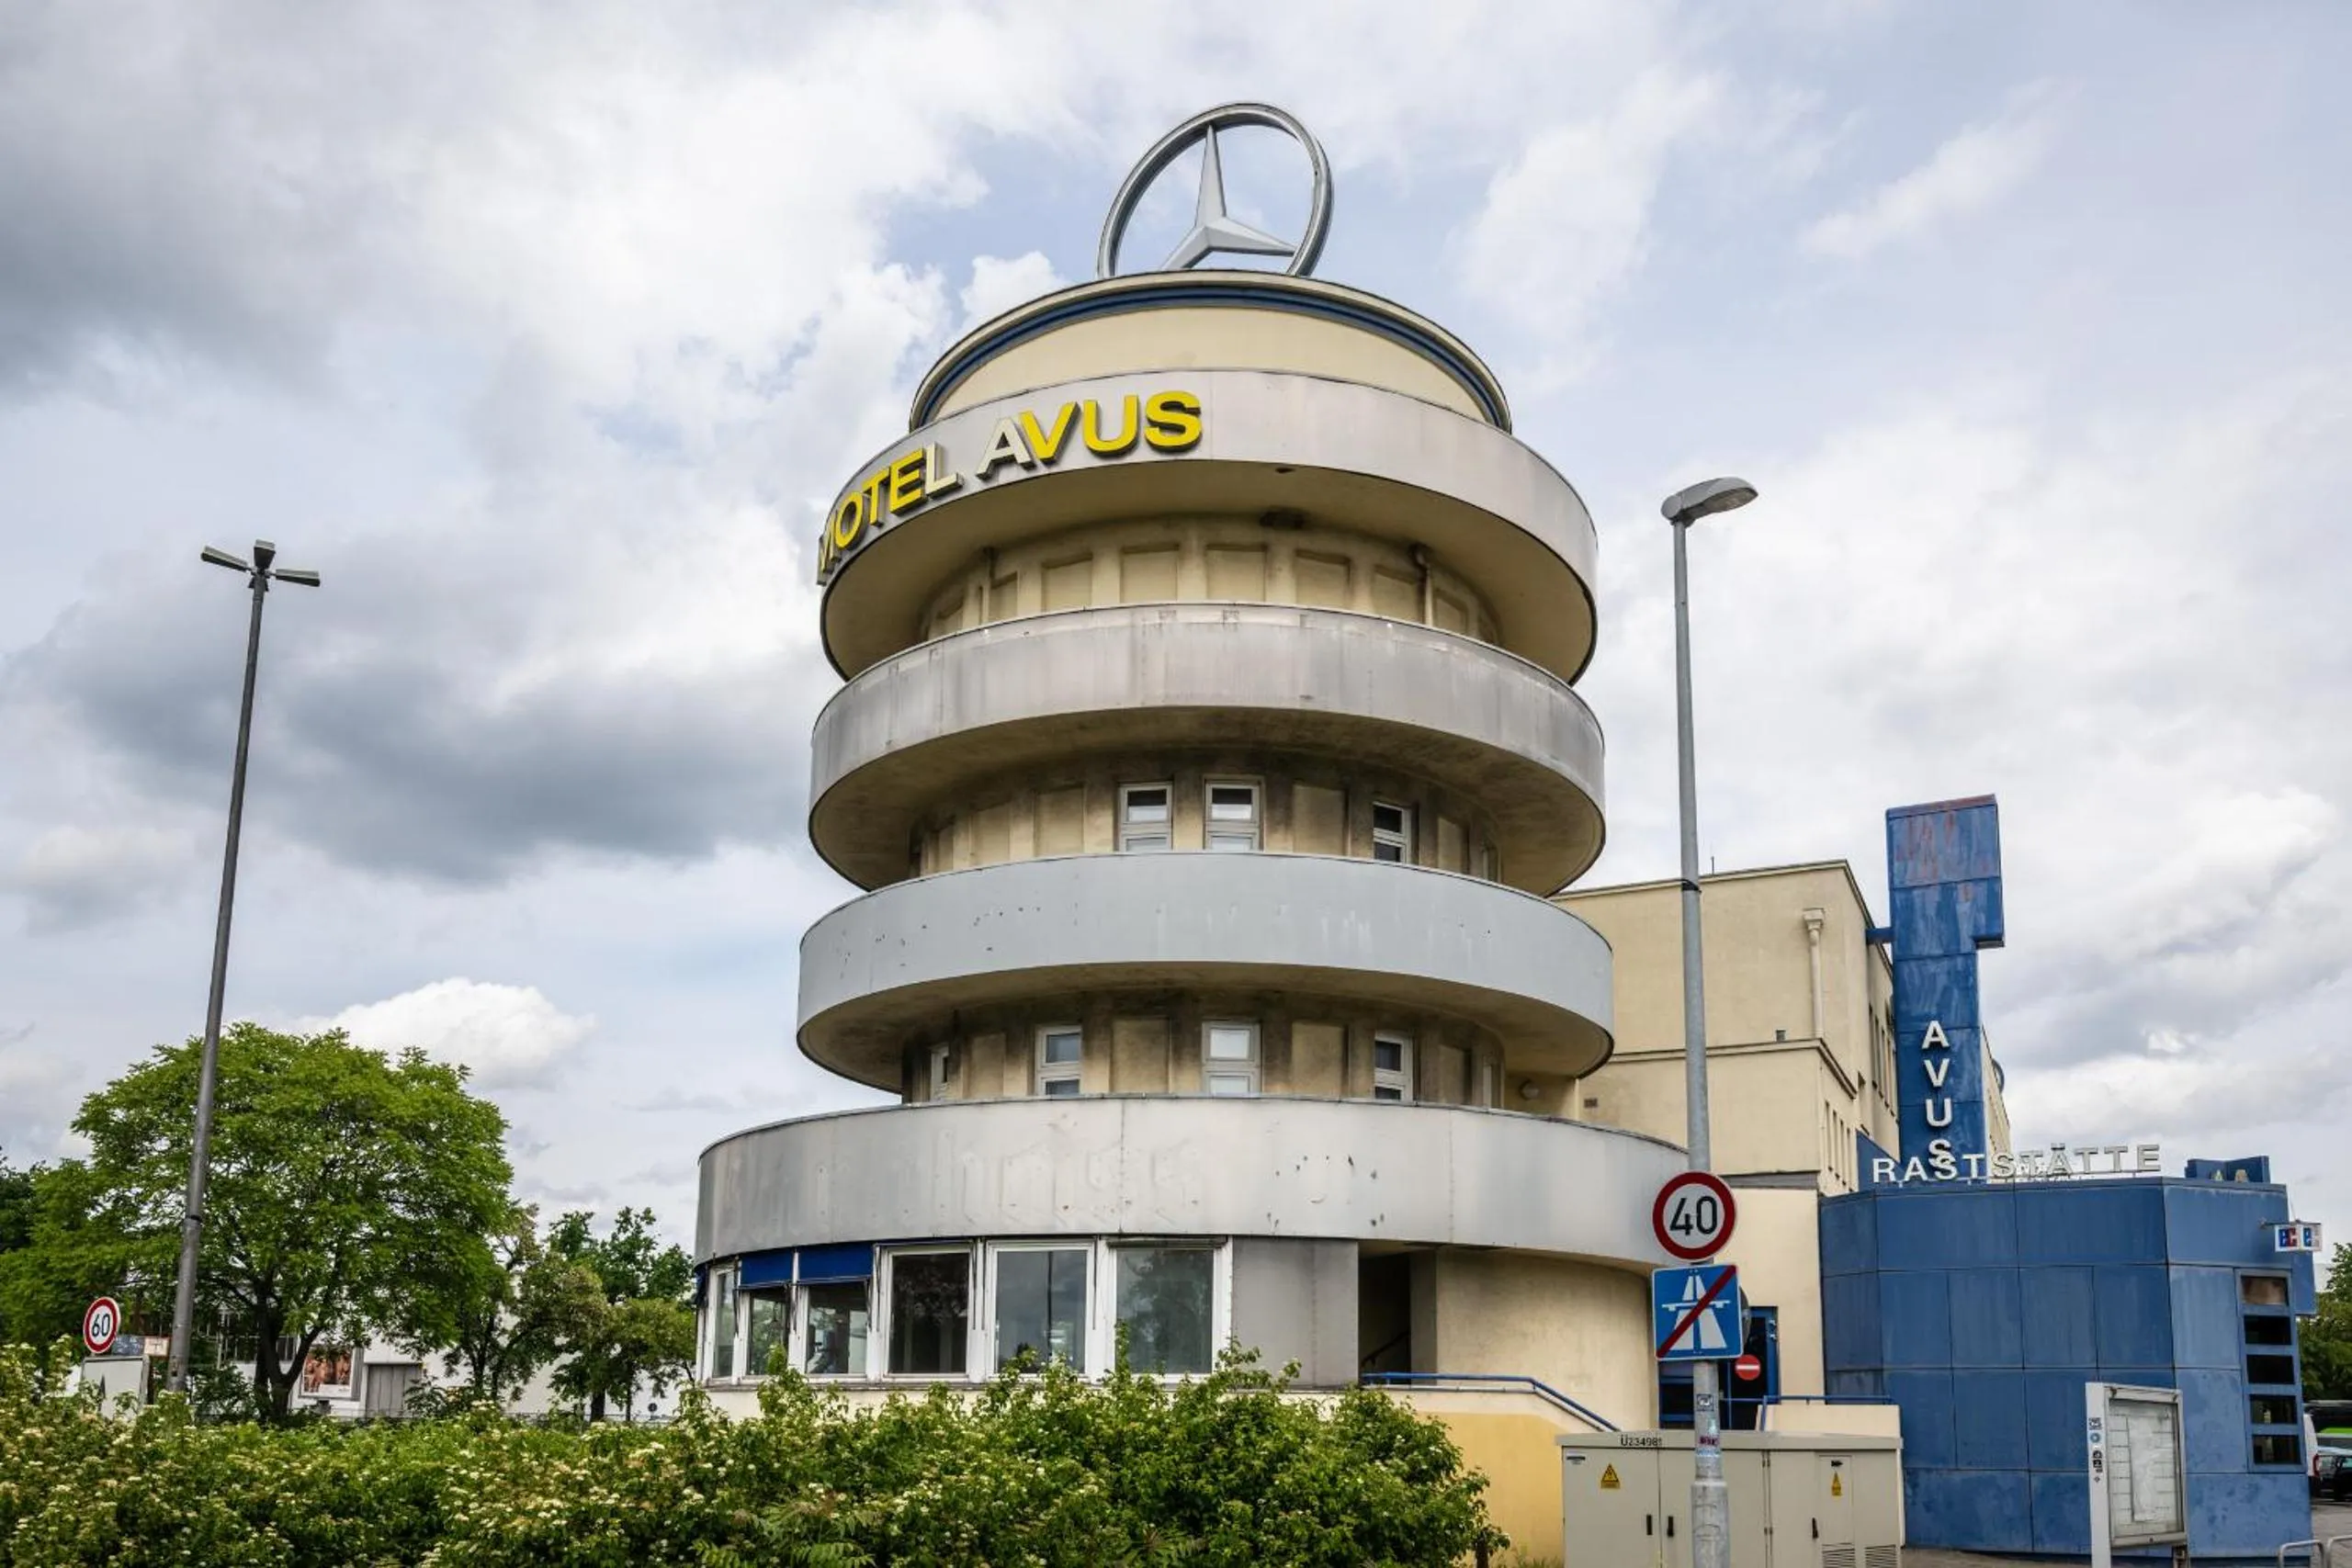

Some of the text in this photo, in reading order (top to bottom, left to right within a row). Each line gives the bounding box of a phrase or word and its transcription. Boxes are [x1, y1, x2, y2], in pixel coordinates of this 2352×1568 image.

[817, 390, 1203, 585] MOTEL AVUS
[1921, 1020, 1953, 1168] AVUS
[1872, 1144, 2162, 1183] RASTSTÄTTE
[1669, 1196, 1717, 1235] 40
[92, 1313, 111, 1337] 60
